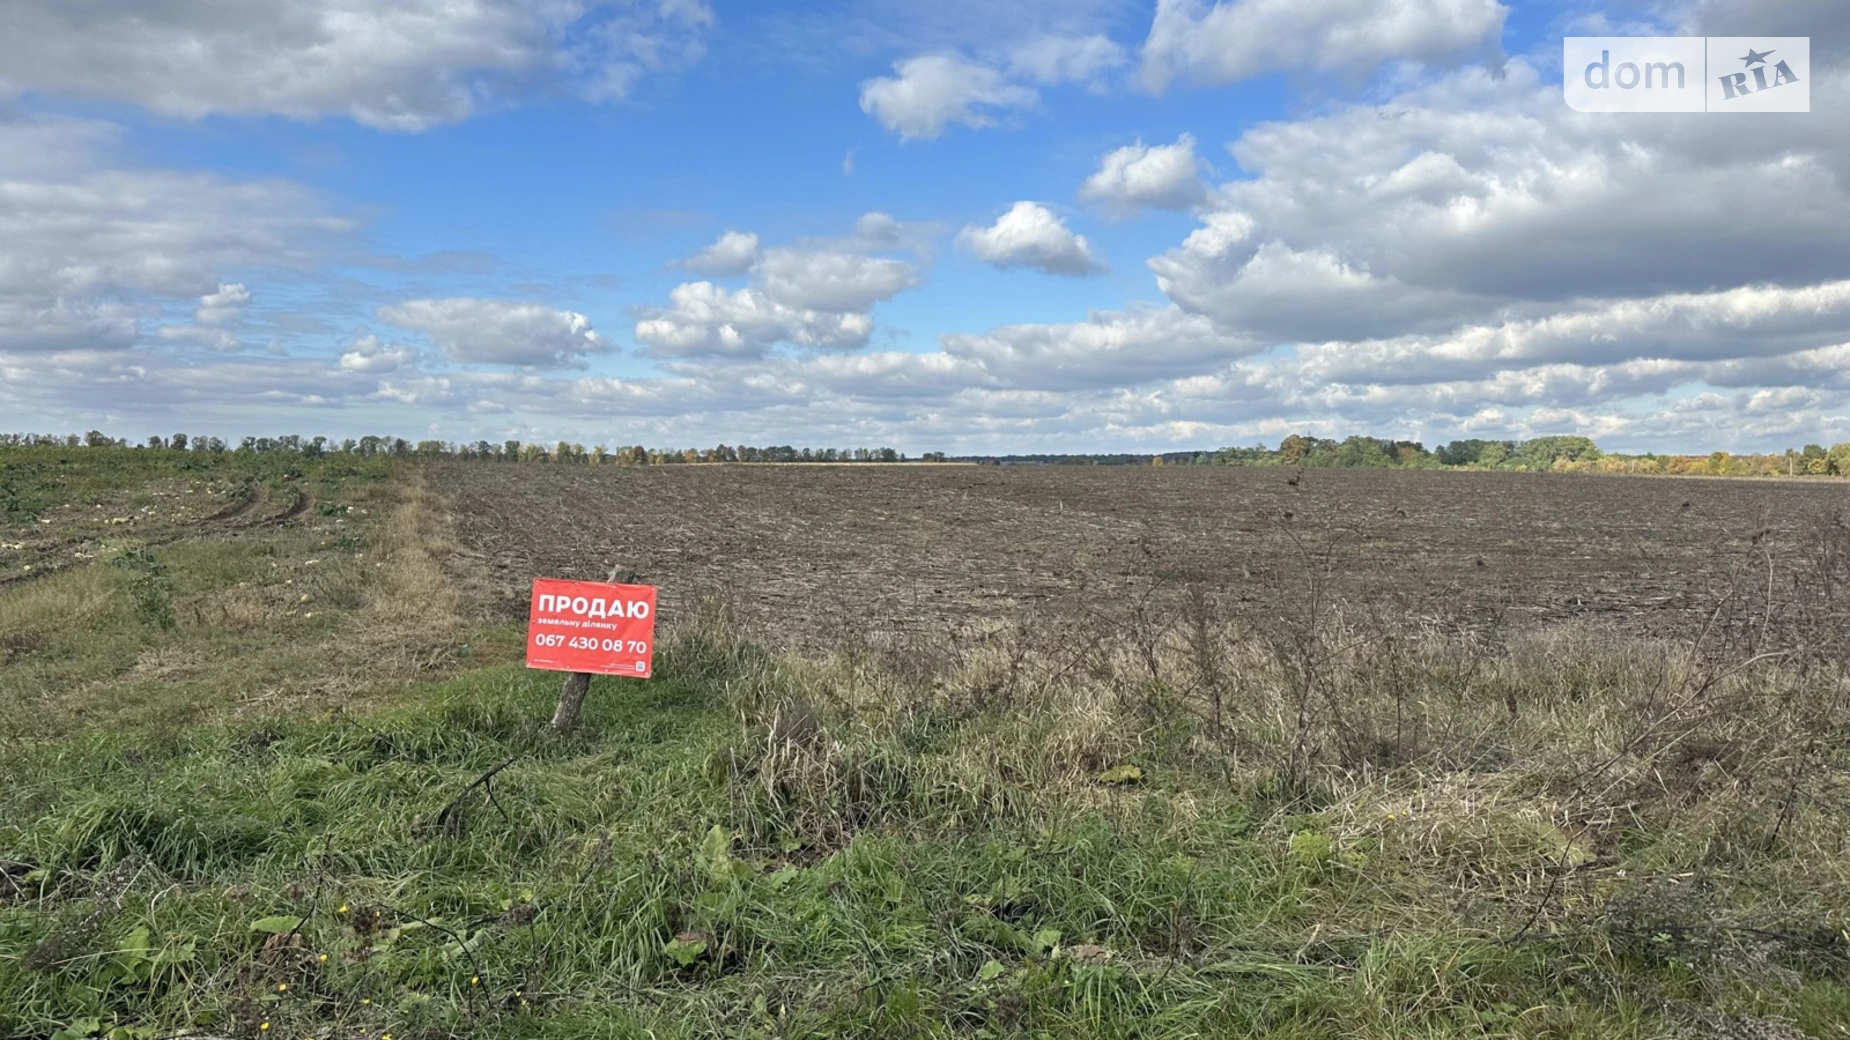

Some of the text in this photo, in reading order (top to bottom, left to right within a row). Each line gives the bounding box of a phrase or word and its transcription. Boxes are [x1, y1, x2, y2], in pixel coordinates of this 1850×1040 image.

[538, 594, 649, 619] ПРОДАЮ
[537, 618, 617, 631] земельну ділянку
[535, 633, 647, 654] 067 430 08 70
